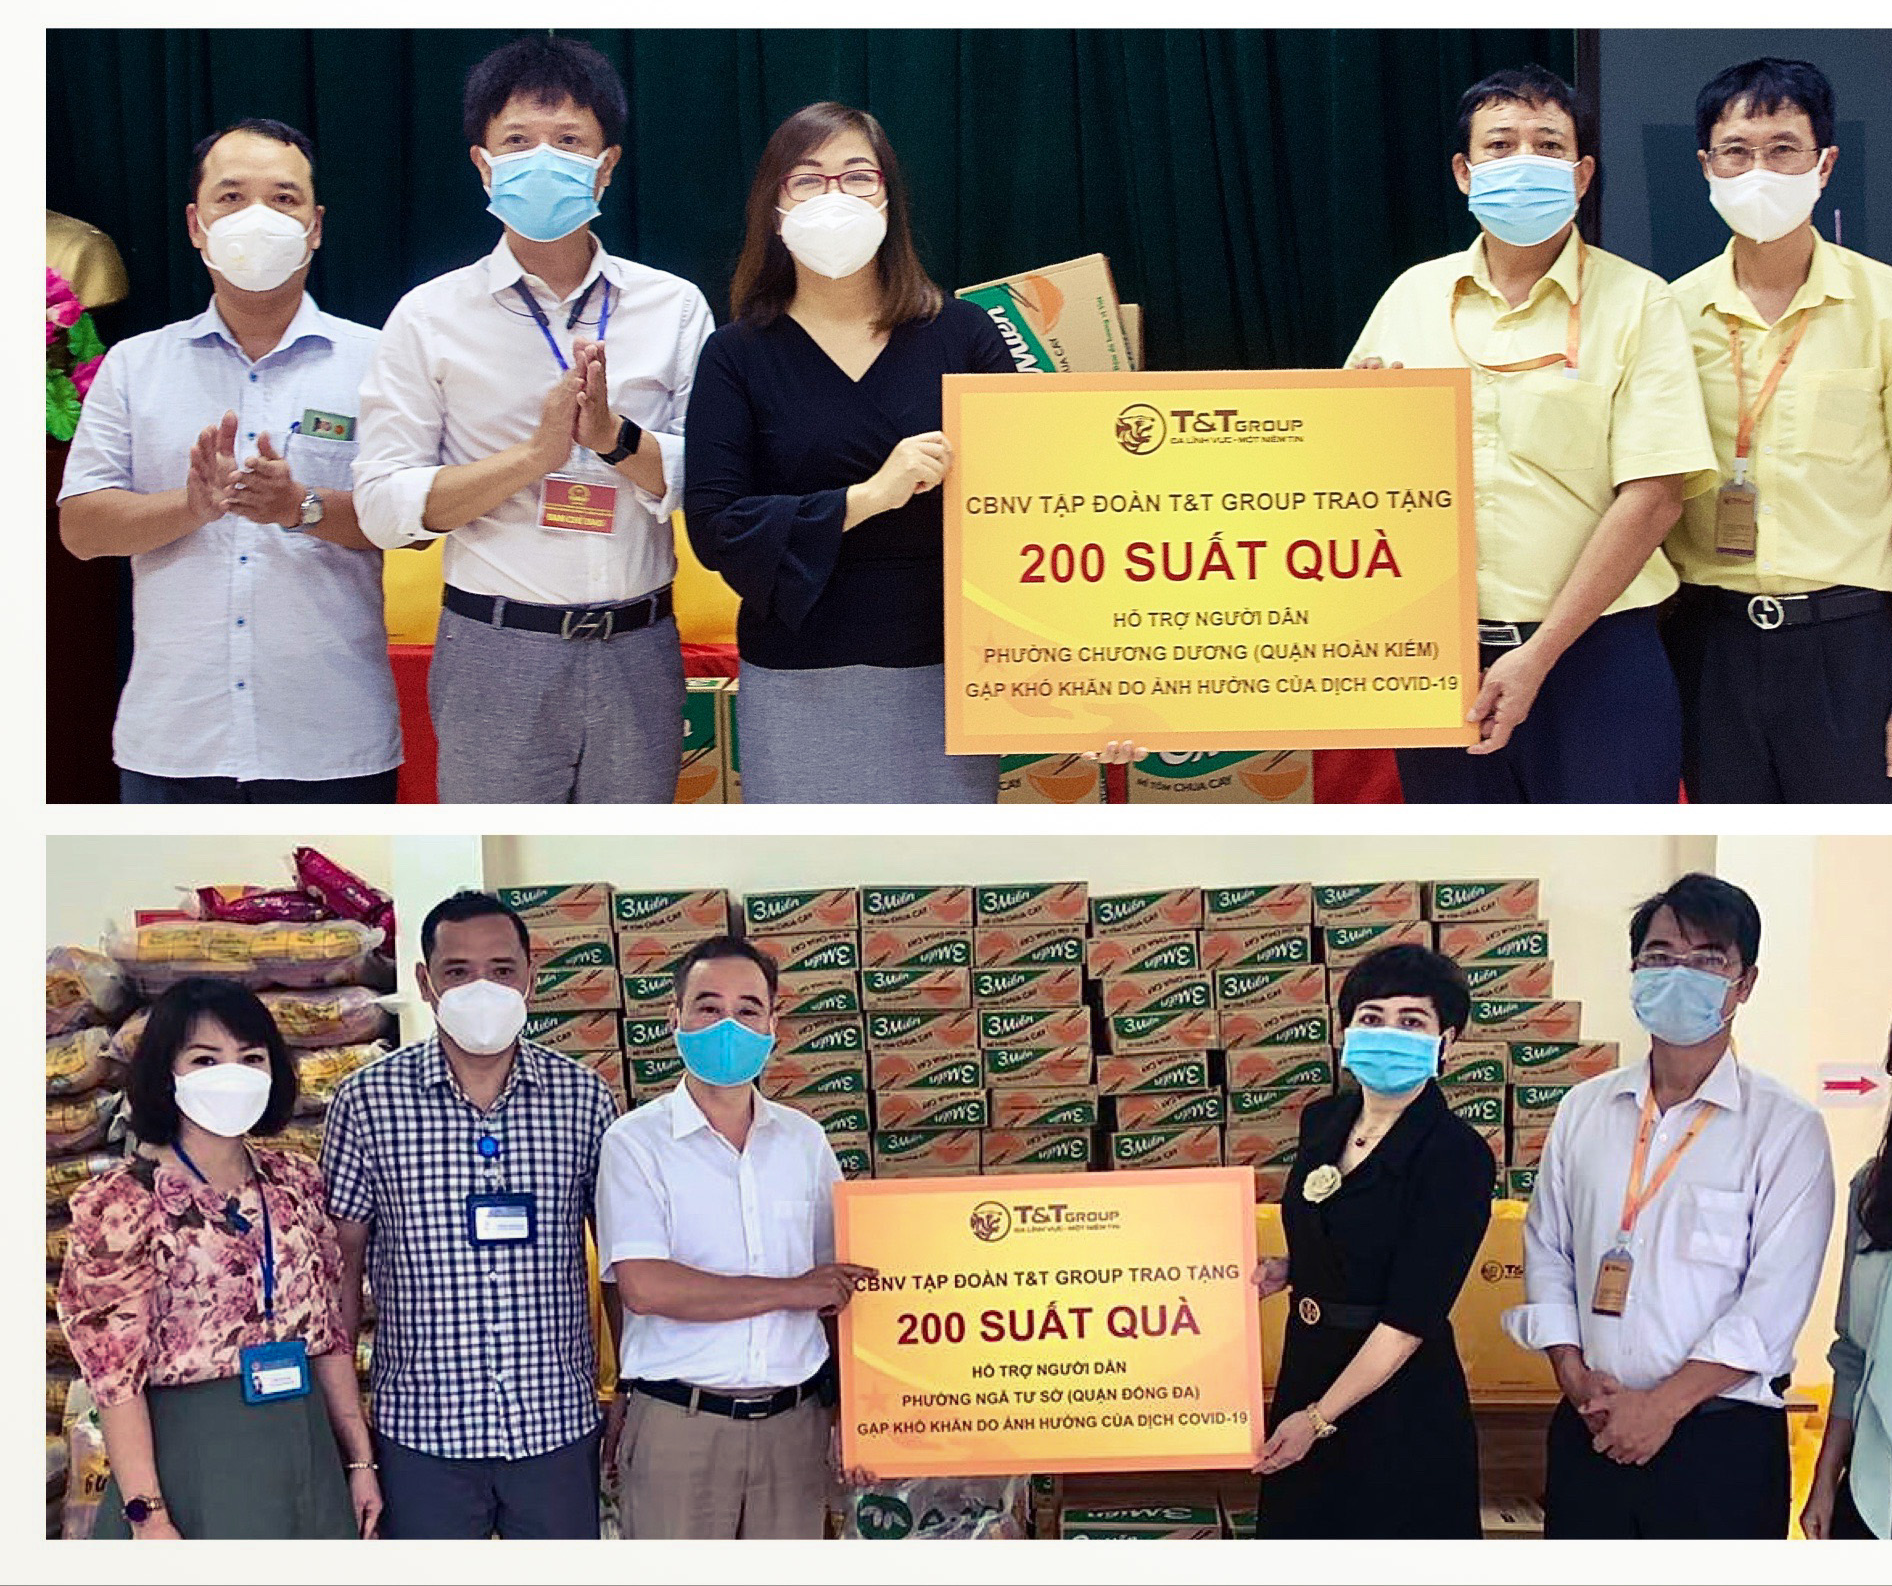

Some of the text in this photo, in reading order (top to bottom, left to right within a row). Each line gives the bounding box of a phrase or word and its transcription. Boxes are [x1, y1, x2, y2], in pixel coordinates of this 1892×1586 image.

[966, 489, 1452, 515] CBNV TẬP ĐOÀN T&T GROUP TRAO TẶNG
[1019, 529, 1402, 583] 200 SUẤT QUÀ
[1148, 610, 1190, 630] TRỢ
[1196, 607, 1262, 626] NGƯỜI
[1268, 607, 1309, 625] DÂN
[983, 644, 1073, 663] PHƯỜNG
[1079, 643, 1168, 662] CHƯƠNG
[1173, 643, 1248, 661] DƯƠNG
[1253, 643, 1318, 663] (QUẬN
[1323, 639, 1380, 659] HOÀN
[1118, 679, 1147, 696] DO
[1281, 673, 1318, 693] CỦA
[1322, 675, 1368, 695] DỊCH
[1373, 674, 1459, 692] COVID-19
[912, 1274, 948, 1293] TẬP
[954, 1270, 1008, 1289] ĐOÀN
[1014, 1270, 1049, 1286] T&T
[1055, 1268, 1123, 1285] GROUP
[1128, 1266, 1181, 1283] TRAO
[1188, 1264, 1240, 1283] TẶNG
[897, 1296, 1201, 1345] 200 SUẤT QUÀ
[1000, 1364, 1032, 1380] TRỢ
[1094, 1360, 1127, 1375] DÂN
[1015, 1388, 1037, 1404] TƯ
[1172, 1386, 1201, 1399] ĐA)
